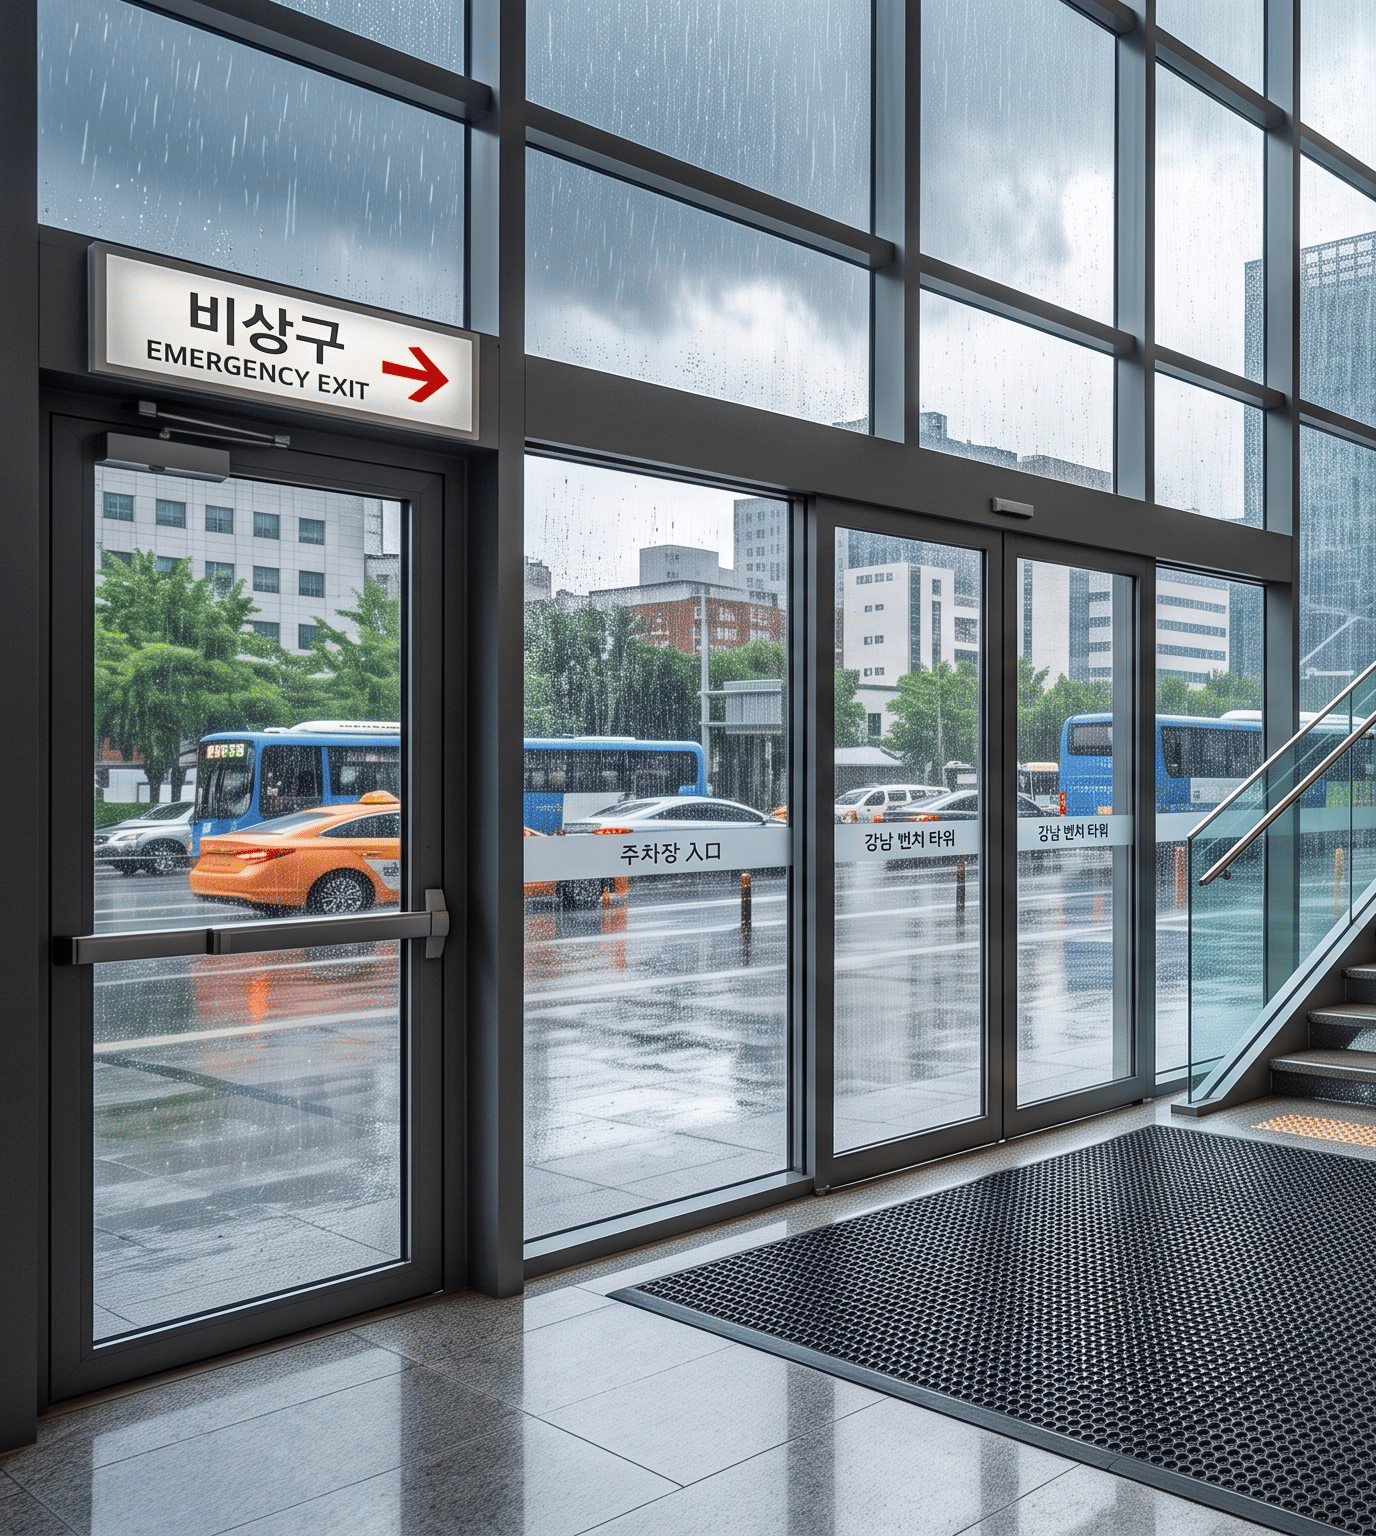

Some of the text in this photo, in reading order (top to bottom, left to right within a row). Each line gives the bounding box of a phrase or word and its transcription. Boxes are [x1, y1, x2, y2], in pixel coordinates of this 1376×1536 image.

[189, 291, 345, 365] 비상구
[147, 340, 370, 400] EMERGENCY EXIT
[864, 832, 894, 852] 강남
[1038, 825, 1061, 842] 강남
[620, 842, 681, 866] 주차장
